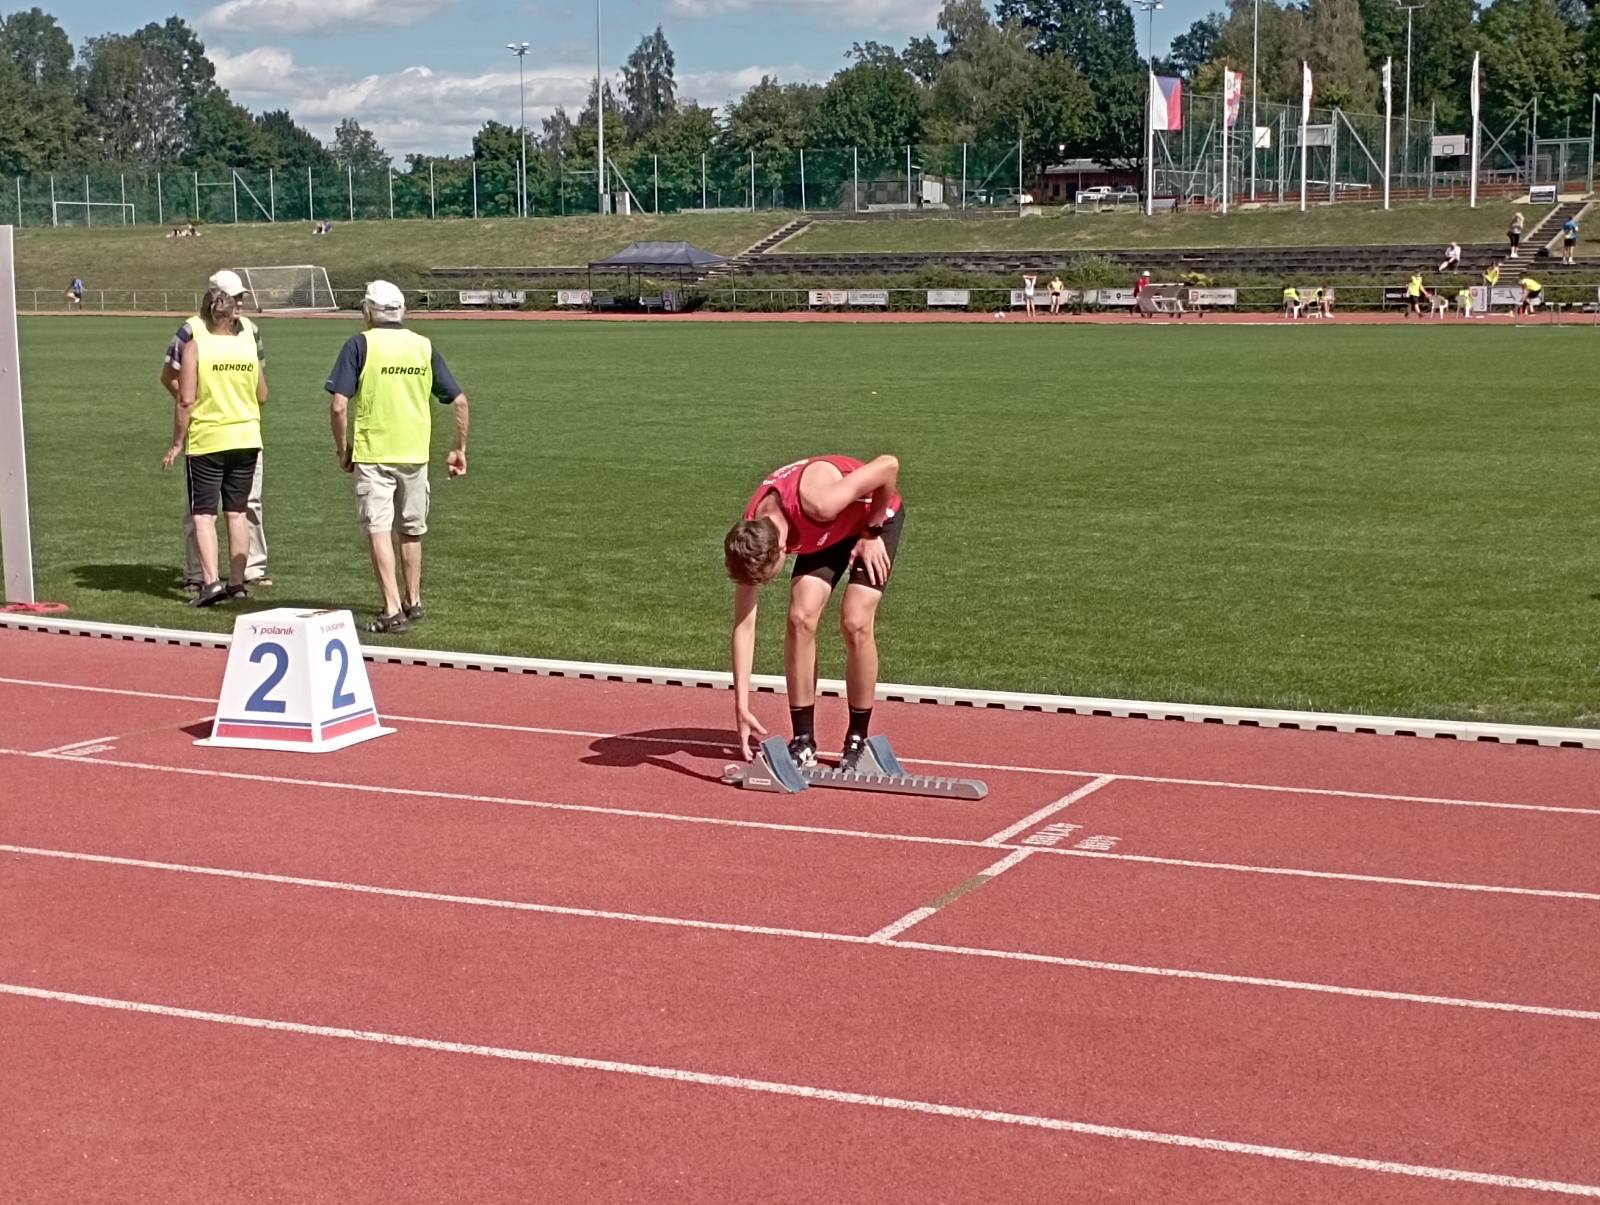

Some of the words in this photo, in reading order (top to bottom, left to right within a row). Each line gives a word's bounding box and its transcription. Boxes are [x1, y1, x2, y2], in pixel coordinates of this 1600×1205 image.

[260, 625, 295, 636] polanik
[325, 622, 346, 634] polanik
[244, 641, 289, 713] 2
[324, 638, 356, 710] 2
